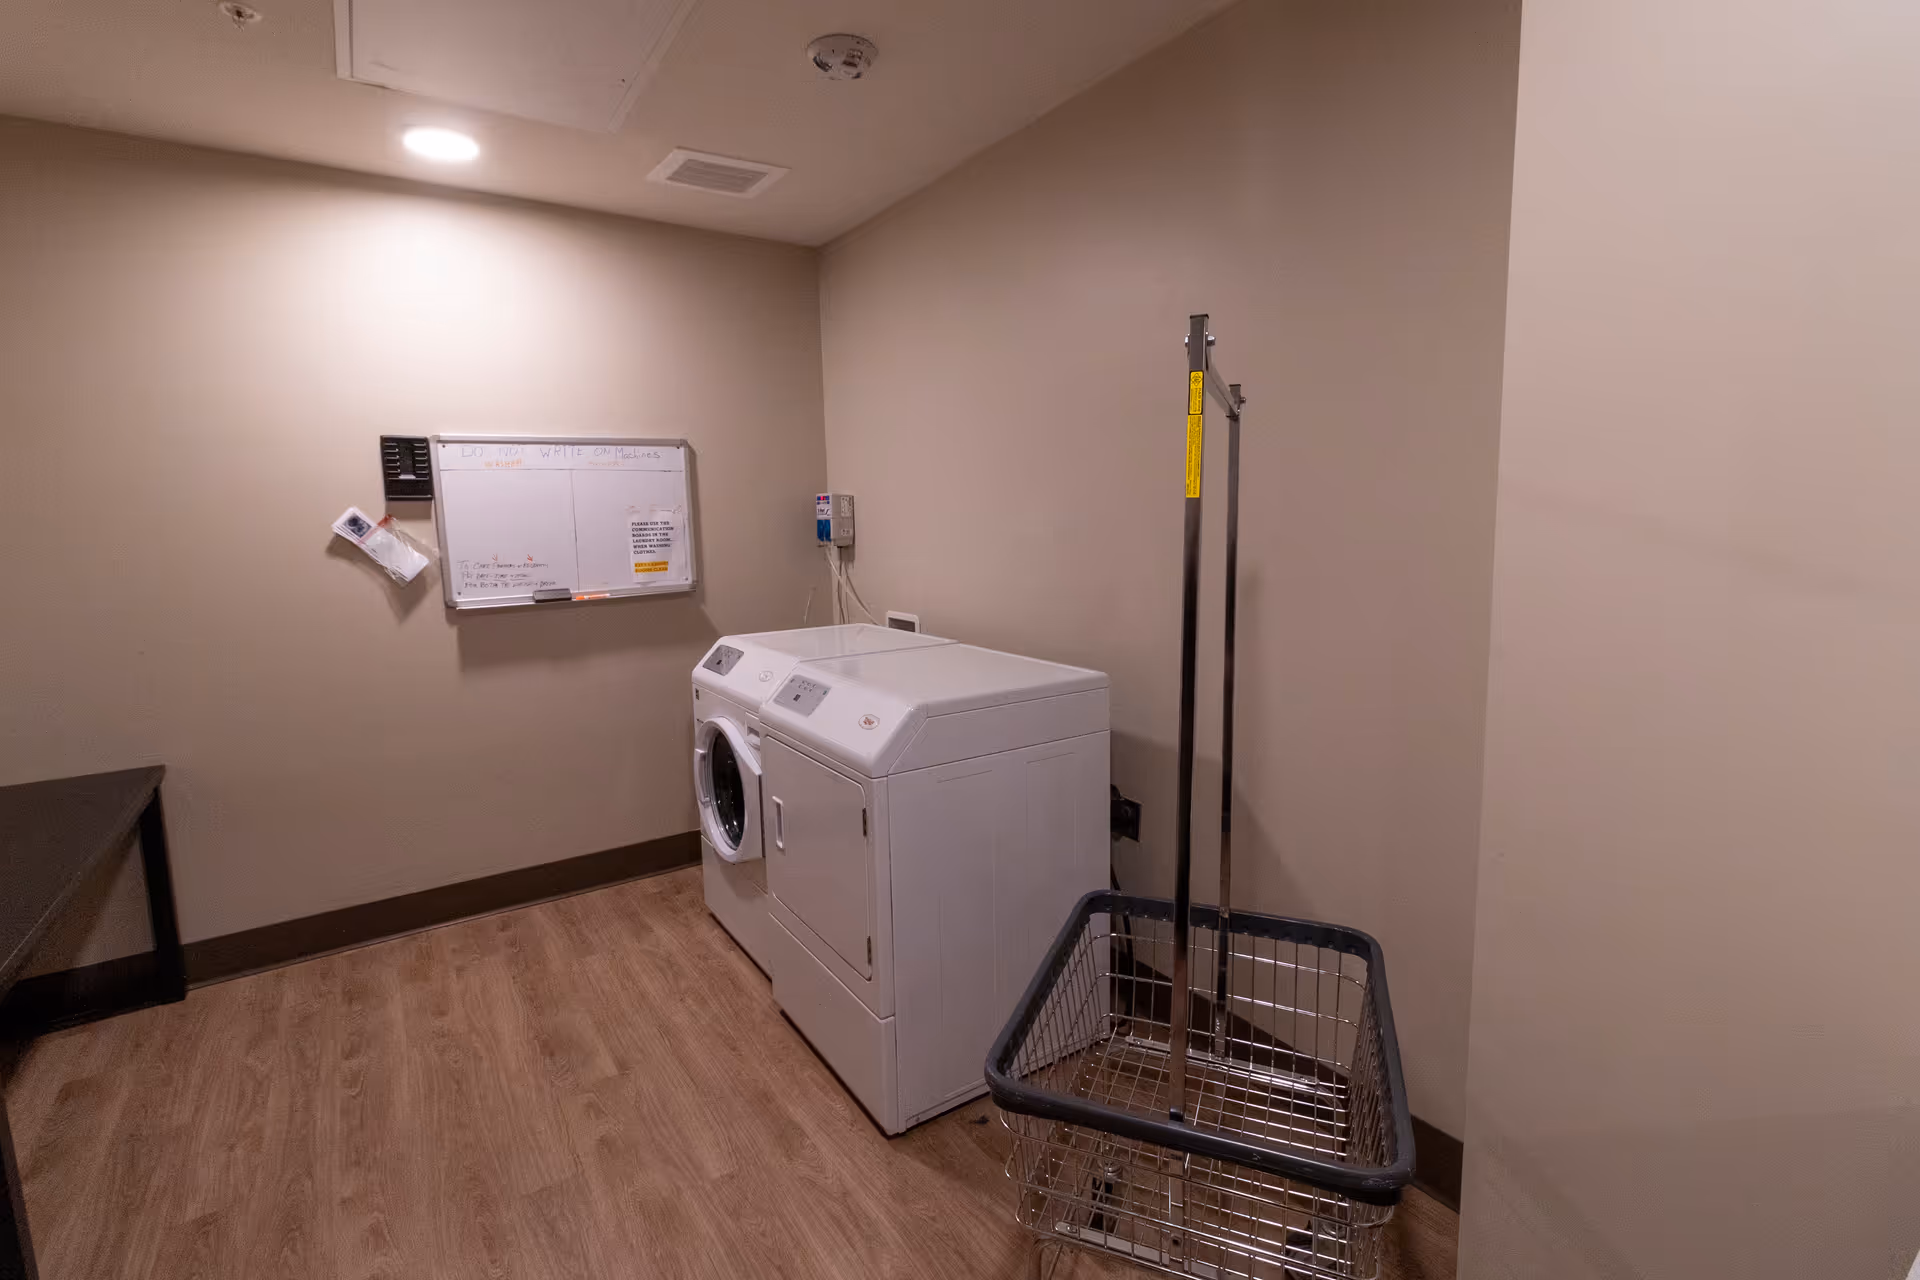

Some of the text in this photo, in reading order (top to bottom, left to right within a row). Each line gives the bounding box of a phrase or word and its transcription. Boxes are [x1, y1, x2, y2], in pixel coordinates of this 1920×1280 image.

[460, 446, 484, 458] DO
[540, 445, 584, 459] WRITE
[594, 447, 611, 457] ON
